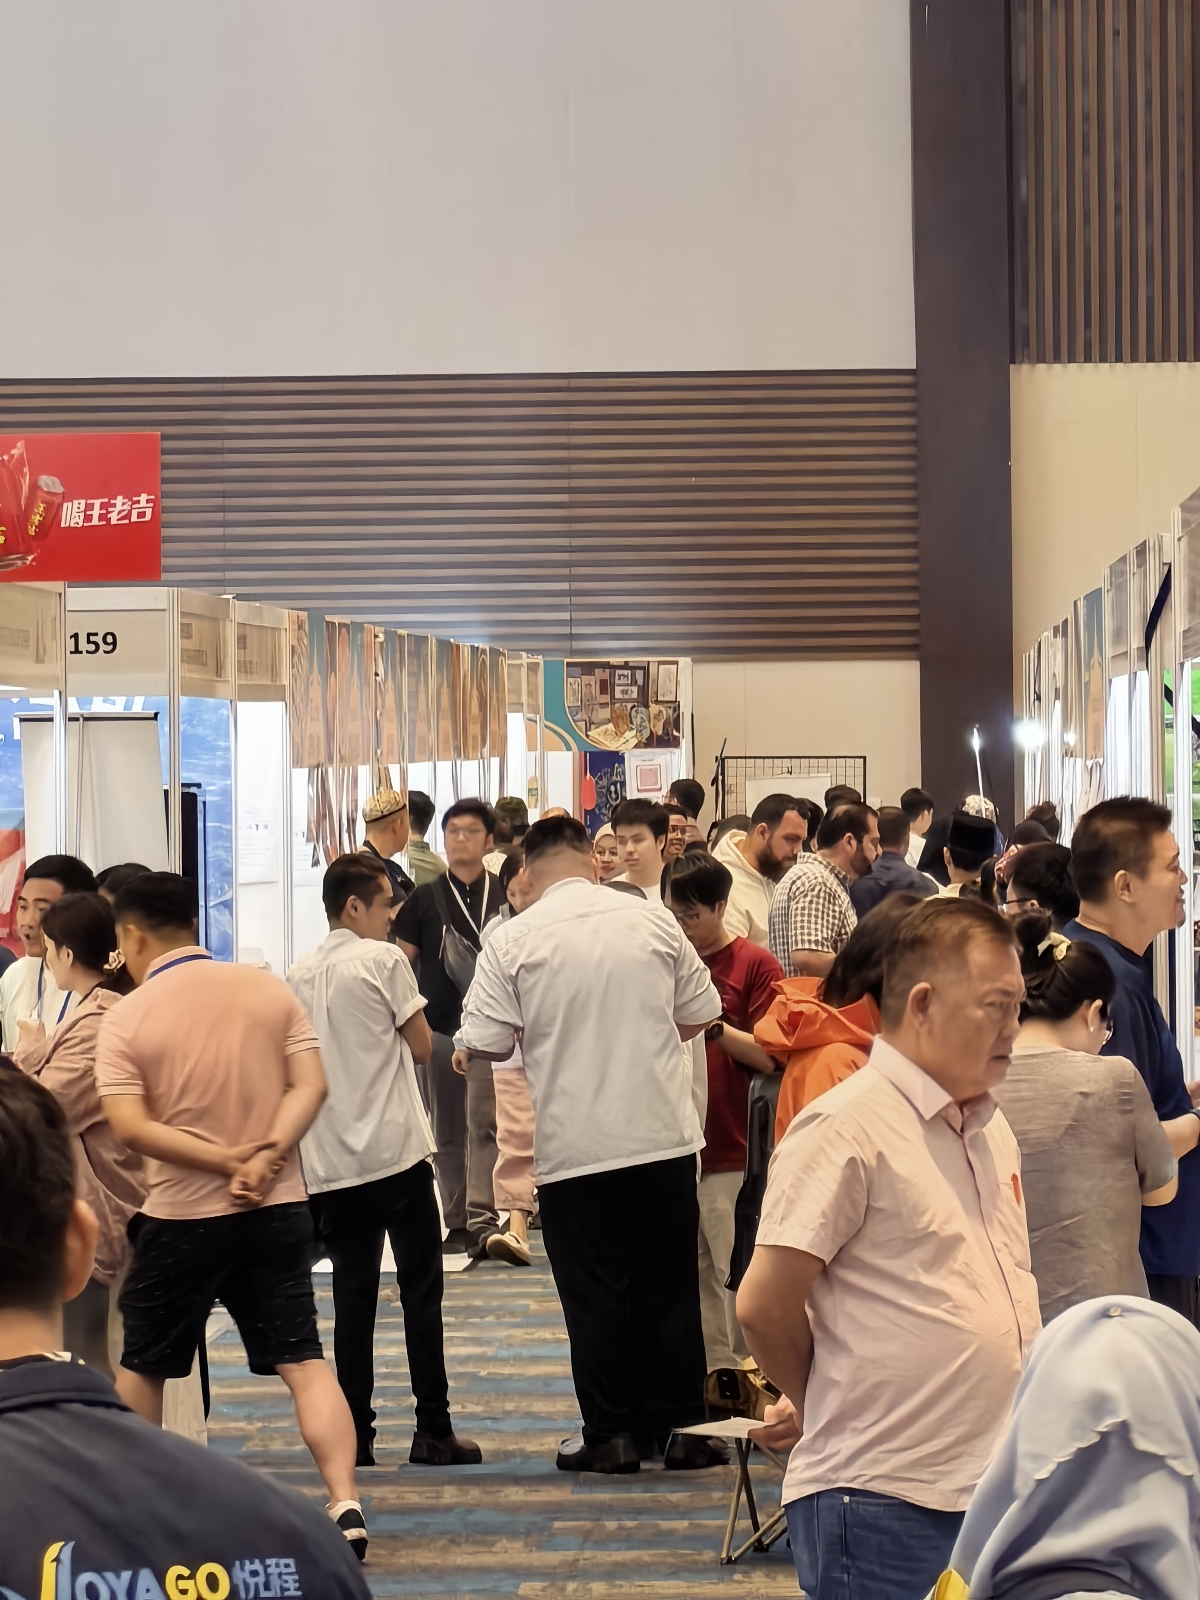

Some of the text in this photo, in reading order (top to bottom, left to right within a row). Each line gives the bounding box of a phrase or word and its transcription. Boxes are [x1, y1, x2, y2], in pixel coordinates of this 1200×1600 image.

[61, 493, 155, 528] 喝王老吉
[69, 631, 118, 655] 159
